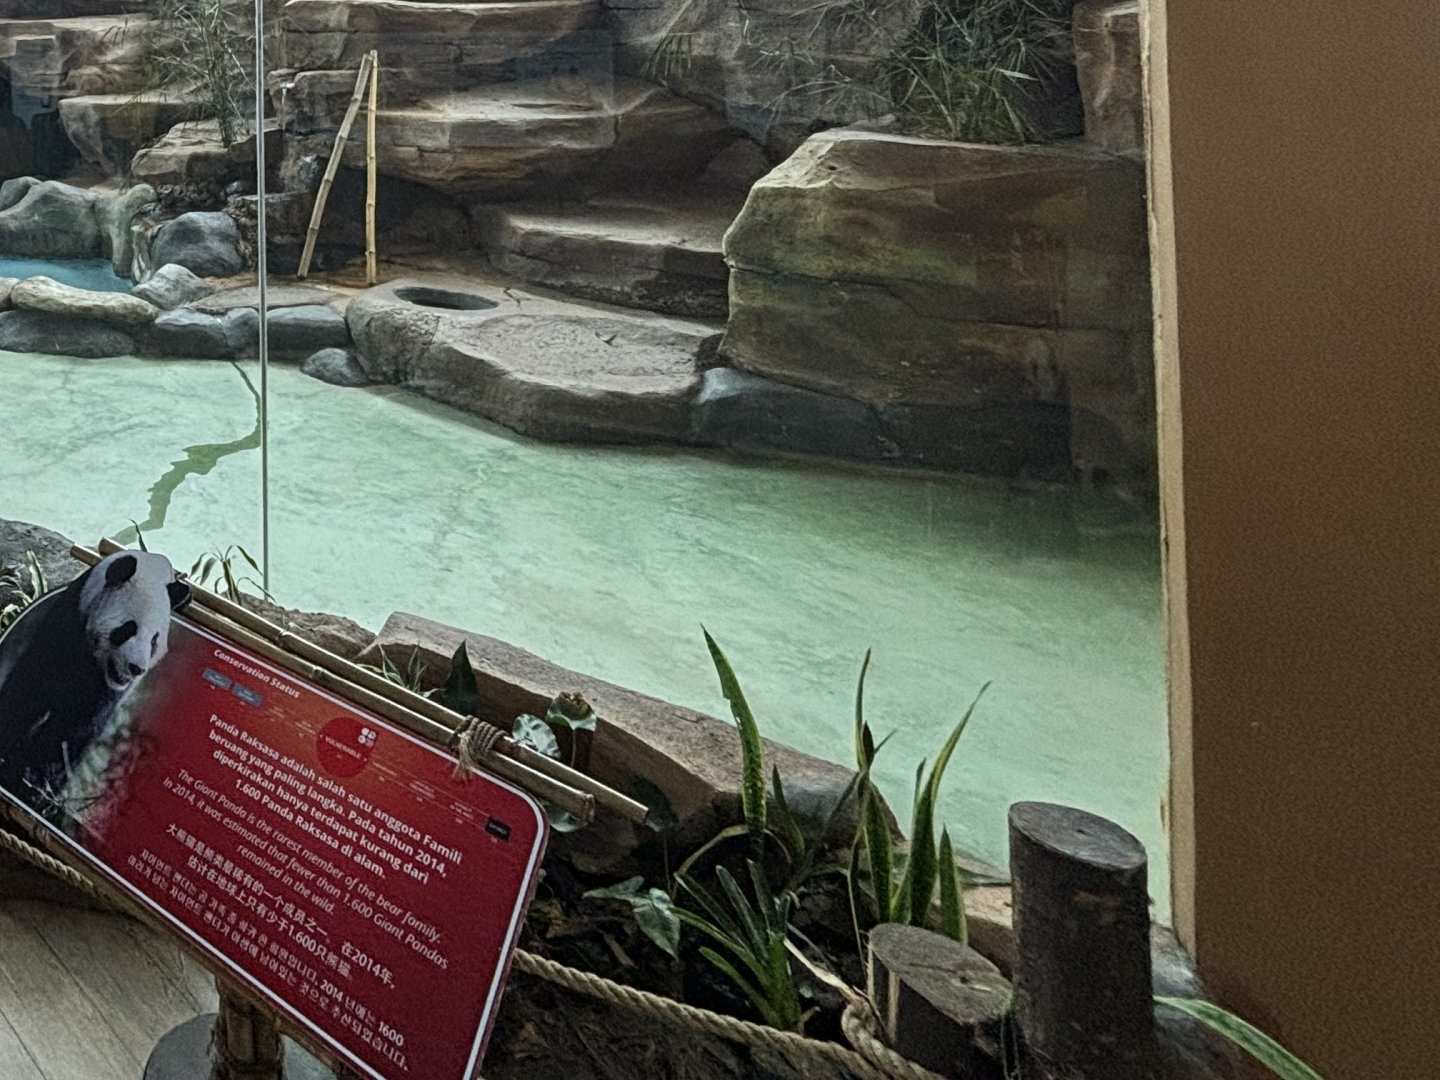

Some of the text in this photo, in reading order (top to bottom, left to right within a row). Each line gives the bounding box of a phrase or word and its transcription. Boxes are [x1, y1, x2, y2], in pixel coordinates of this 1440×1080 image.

[213, 648, 271, 683] Conservation
[269, 677, 301, 699] Status
[177, 768, 441, 944] The Giant Panda is the rarest member of the bear family.
[208, 728, 447, 878] beruang yang paling langka. Pada tahun 2014,
[209, 713, 240, 737] Panda
[239, 730, 280, 761] Raksasa
[279, 755, 316, 782] adalah
[316, 775, 346, 798] salah
[346, 793, 373, 814] satu
[373, 808, 421, 842] anggota
[422, 834, 463, 865] Famili
[212, 749, 430, 885] diperkirakan hanya terdapat kurang dari
[235, 778, 386, 879] 1.600 Panda Raksasa di alam.
[162, 776, 449, 970] In 2014, it was estimated that fewer than 1.600 Giant Pandas
[168, 884, 203, 916] 자이언트
[236, 844, 284, 879] remained
[281, 872, 294, 887] in
[292, 880, 312, 899] the
[139, 848, 173, 877] 자이언트
[319, 978, 344, 1003] 2014
[377, 1020, 405, 1047] 1600
